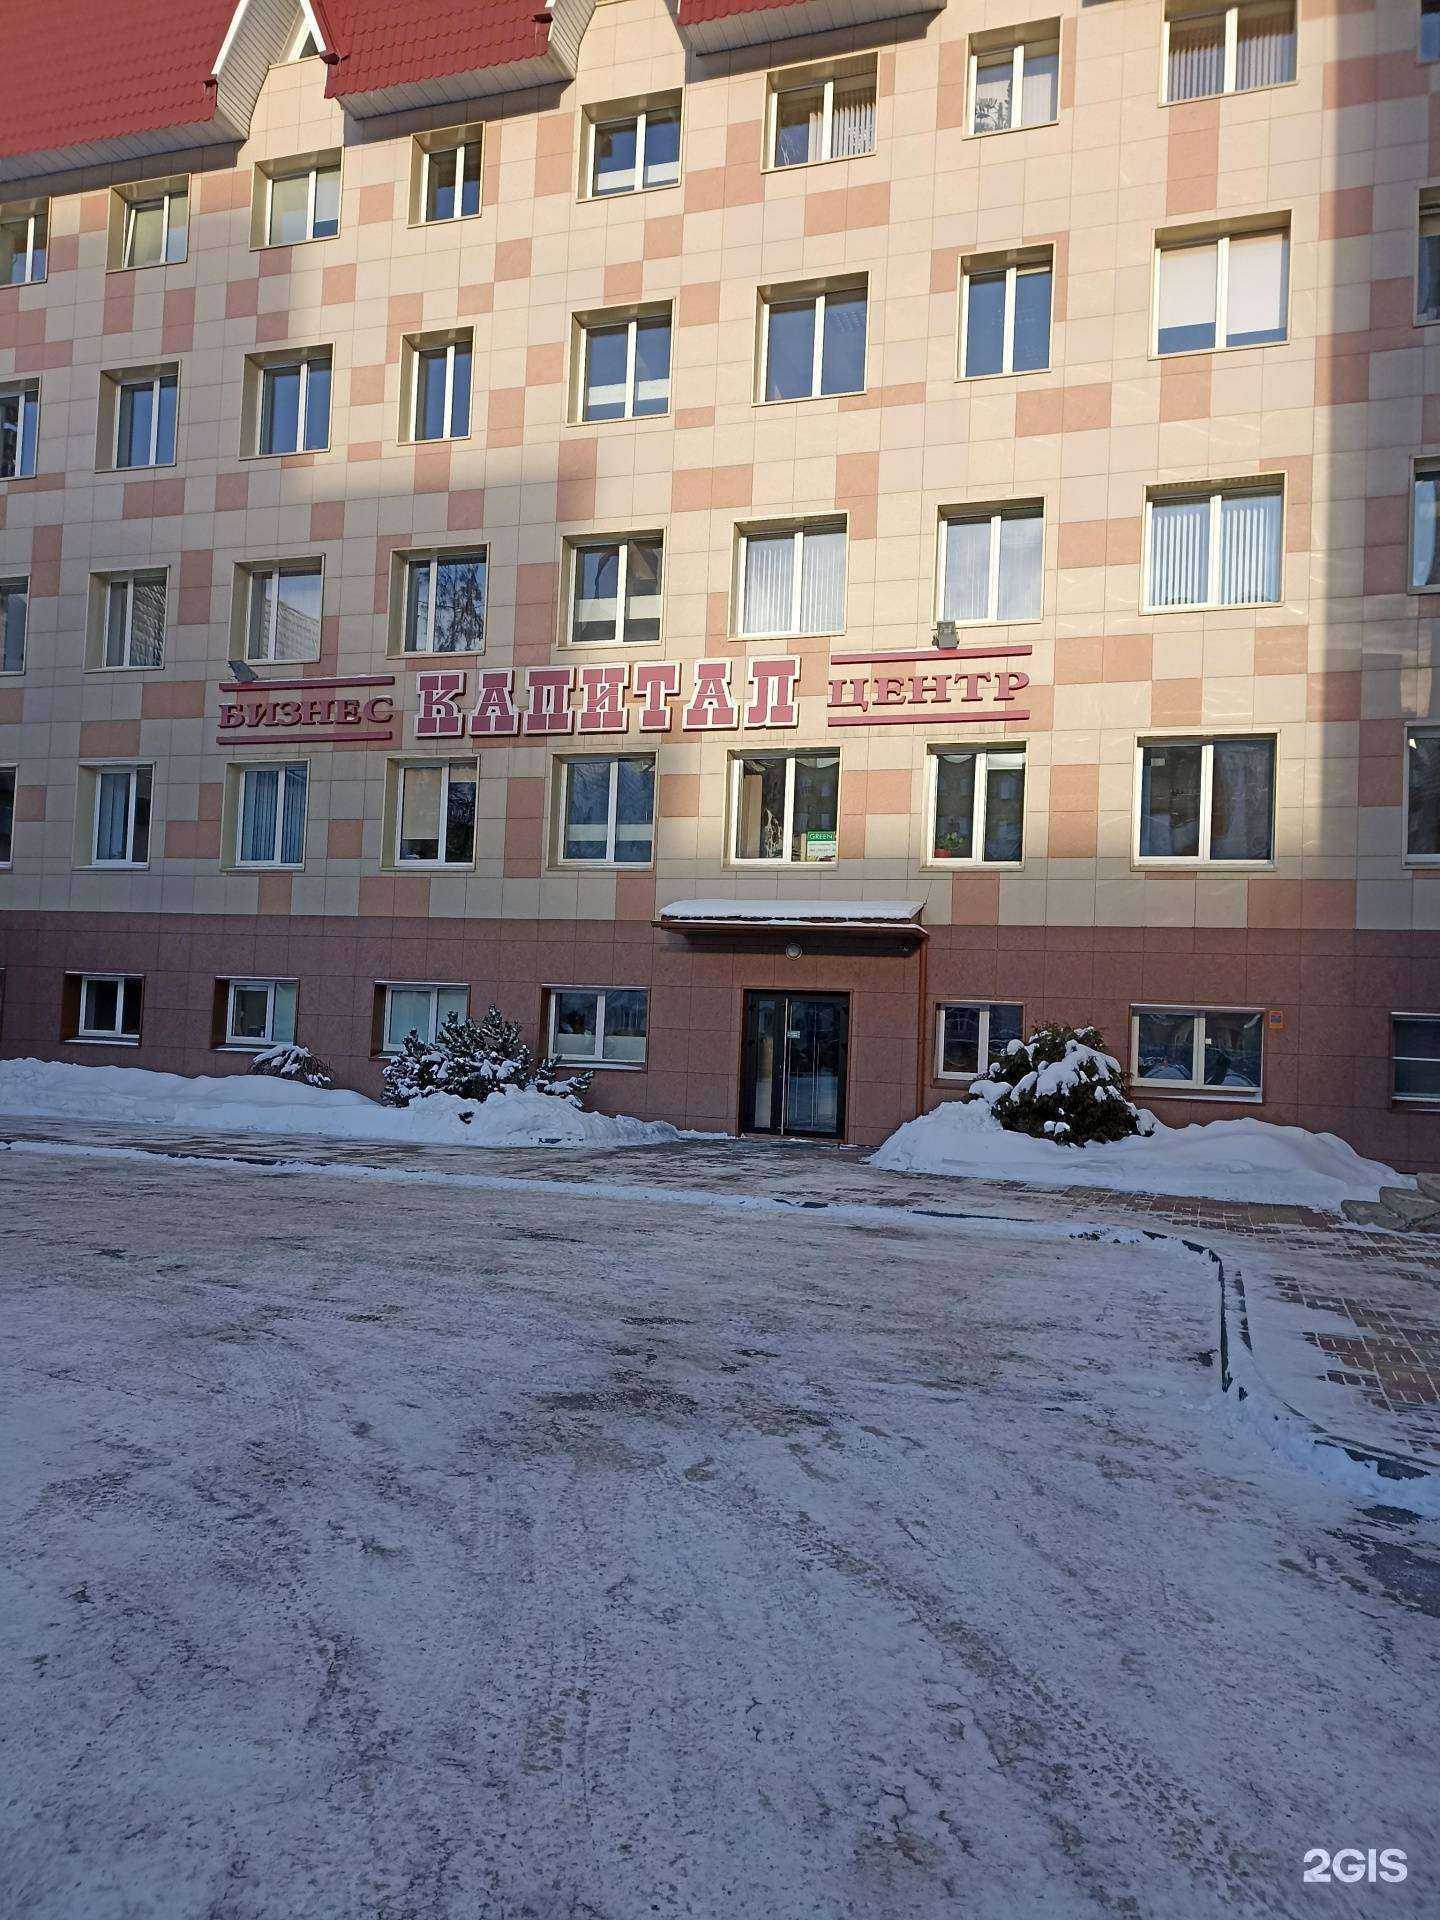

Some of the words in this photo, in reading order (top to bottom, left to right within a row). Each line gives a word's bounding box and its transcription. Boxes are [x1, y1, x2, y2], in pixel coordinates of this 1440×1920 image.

[218, 697, 394, 728] БИЗНЕС
[414, 654, 801, 738] КАПИТАЛ
[827, 671, 1031, 712] ЦЕНТР
